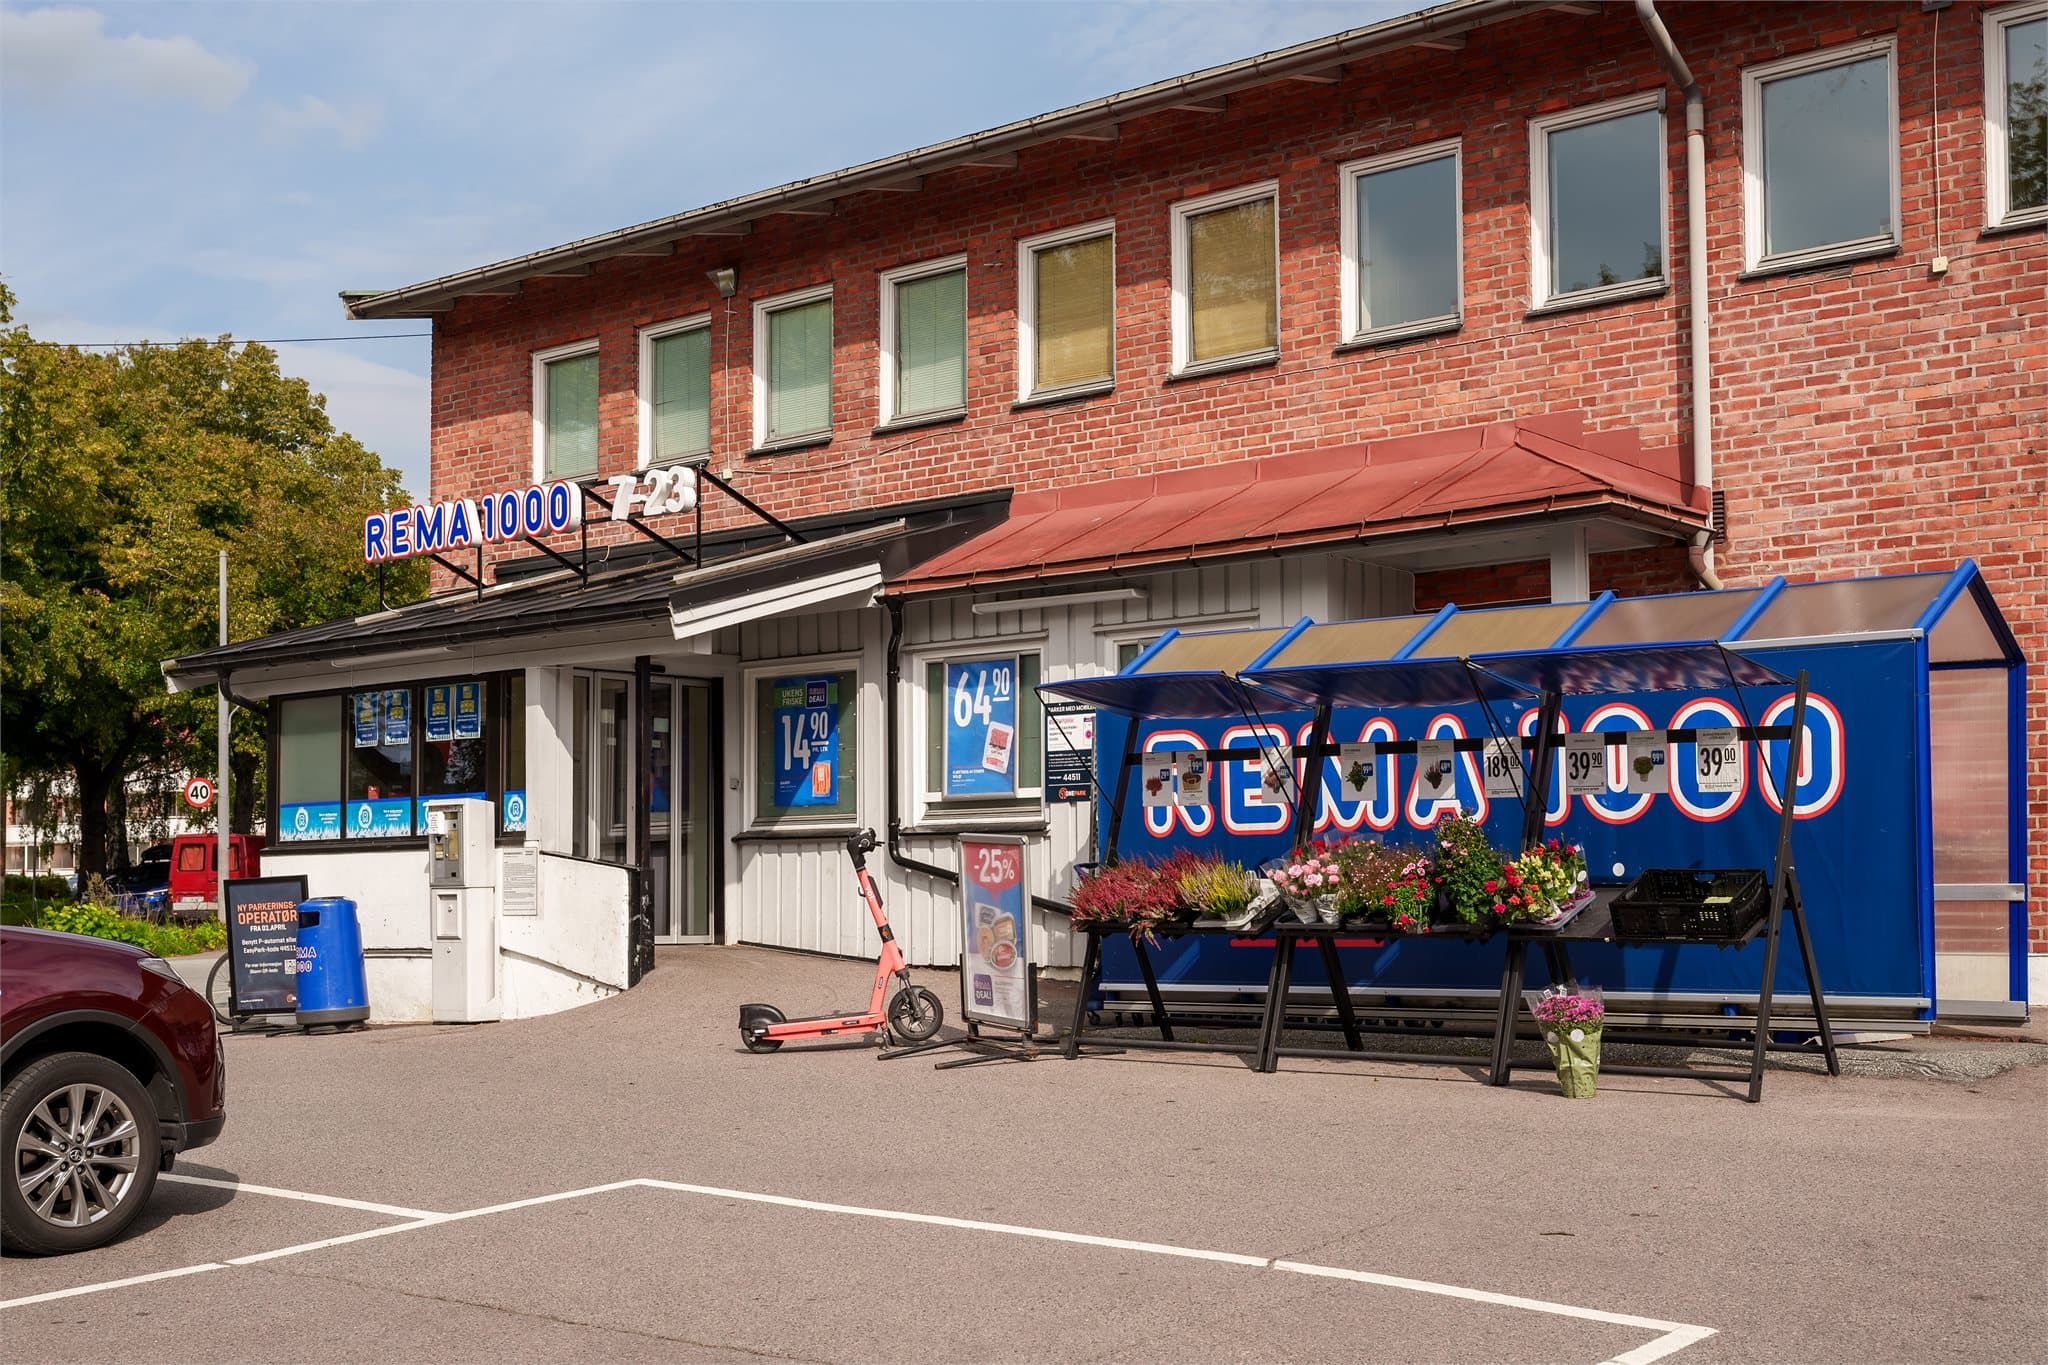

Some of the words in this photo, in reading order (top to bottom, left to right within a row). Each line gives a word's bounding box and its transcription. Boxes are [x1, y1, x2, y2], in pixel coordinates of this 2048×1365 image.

[608, 466, 697, 521] 7-23
[364, 497, 474, 563] REMA
[481, 480, 572, 545] 1000
[782, 688, 803, 697] UKENS
[782, 697, 803, 706] FRISKE
[954, 670, 992, 727] 64
[992, 667, 1010, 696] 90
[782, 714, 811, 770] 14
[811, 712, 828, 739] 90
[1487, 755, 1508, 777] 189
[1568, 752, 1590, 780] 39
[1592, 752, 1602, 766] 90
[1700, 747, 1722, 777] 39
[1724, 748, 1736, 761] 00
[1062, 773, 1080, 781] 44511
[1142, 713, 1489, 838] REMA
[190, 785, 209, 799] 40
[974, 848, 1015, 884] -25%
[237, 903, 248, 912] NY
[248, 901, 296, 912] PARKERINGS-
[238, 909, 298, 925] OPERATØR
[296, 946, 317, 959] EMA
